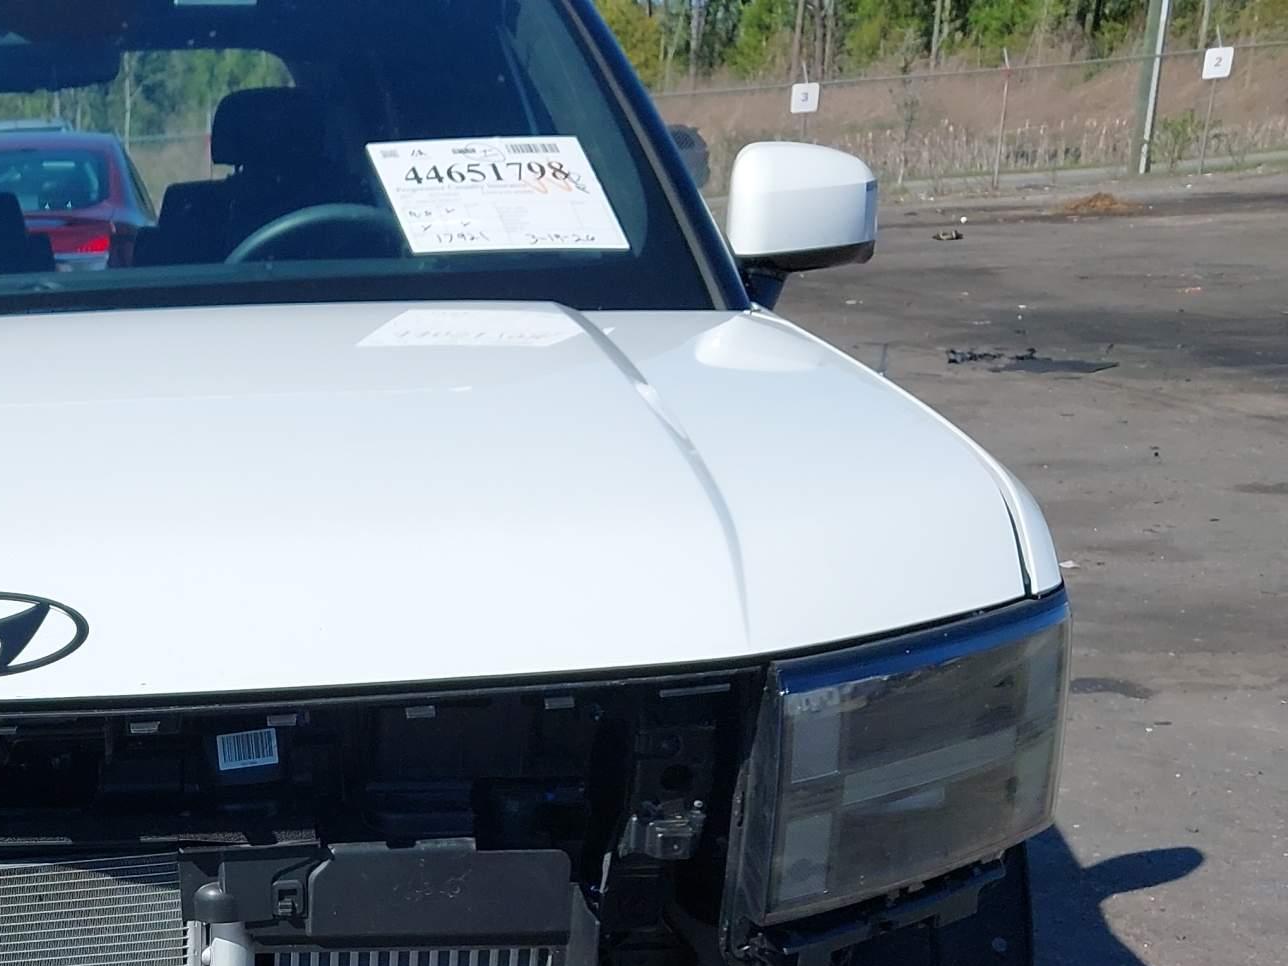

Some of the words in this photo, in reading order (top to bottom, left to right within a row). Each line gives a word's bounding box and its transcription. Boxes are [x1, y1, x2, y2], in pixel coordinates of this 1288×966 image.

[1213, 56, 1223, 67] 2
[799, 91, 810, 103] 3
[404, 160, 570, 185] 44651798
